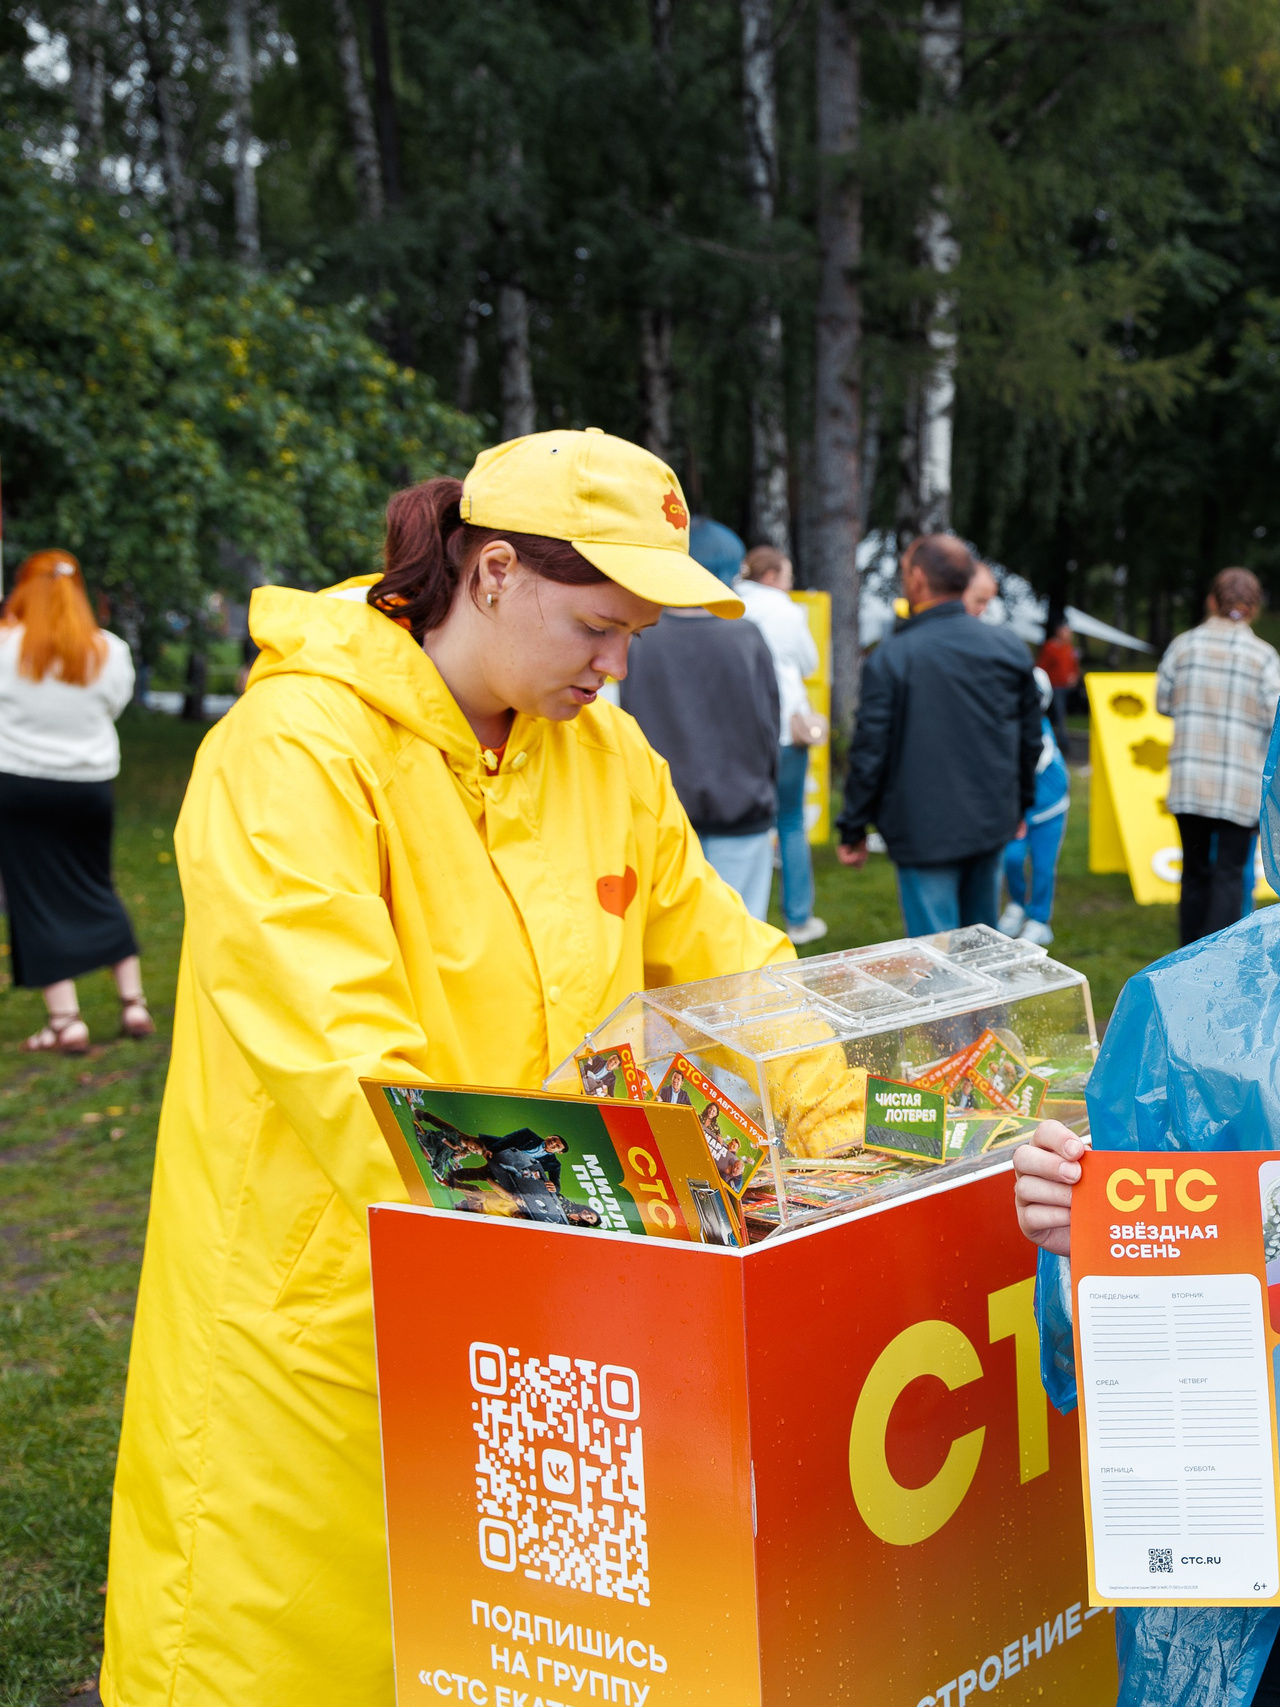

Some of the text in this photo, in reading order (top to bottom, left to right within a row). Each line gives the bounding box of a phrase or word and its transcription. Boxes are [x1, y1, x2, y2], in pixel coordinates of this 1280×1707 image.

[620, 1049, 636, 1082] СТС
[677, 1058, 702, 1085] СТС
[716, 1097, 748, 1129] АВГУСТА
[748, 1126, 768, 1144] 19:0
[875, 1092, 922, 1107] ЧИСТАЯ
[884, 1108, 937, 1123] ЛОТЕРЕЯ
[582, 1154, 632, 1235] МИЛЛ
[627, 1146, 677, 1230] СТС
[1105, 1167, 1219, 1213] СТС
[1109, 1221, 1219, 1243] ЗВЁЗДНАЯ
[1110, 1243, 1181, 1259] ОСЕНЬ
[1089, 1293, 1140, 1301] ПОНЕДЕЛЬНИК
[1171, 1291, 1204, 1299] ВТОРНИК
[1178, 1377, 1209, 1385] ЧЕТВЕРГ
[848, 1275, 1050, 1547] СТ
[1100, 1467, 1134, 1475] ПЯТНИЦА
[1183, 1465, 1216, 1473] СУББОТА
[1252, 1581, 1268, 1592] 6+
[471, 1599, 668, 1674] ПОДПИШИСЬ
[491, 1644, 651, 1707] НА ГРУППУ
